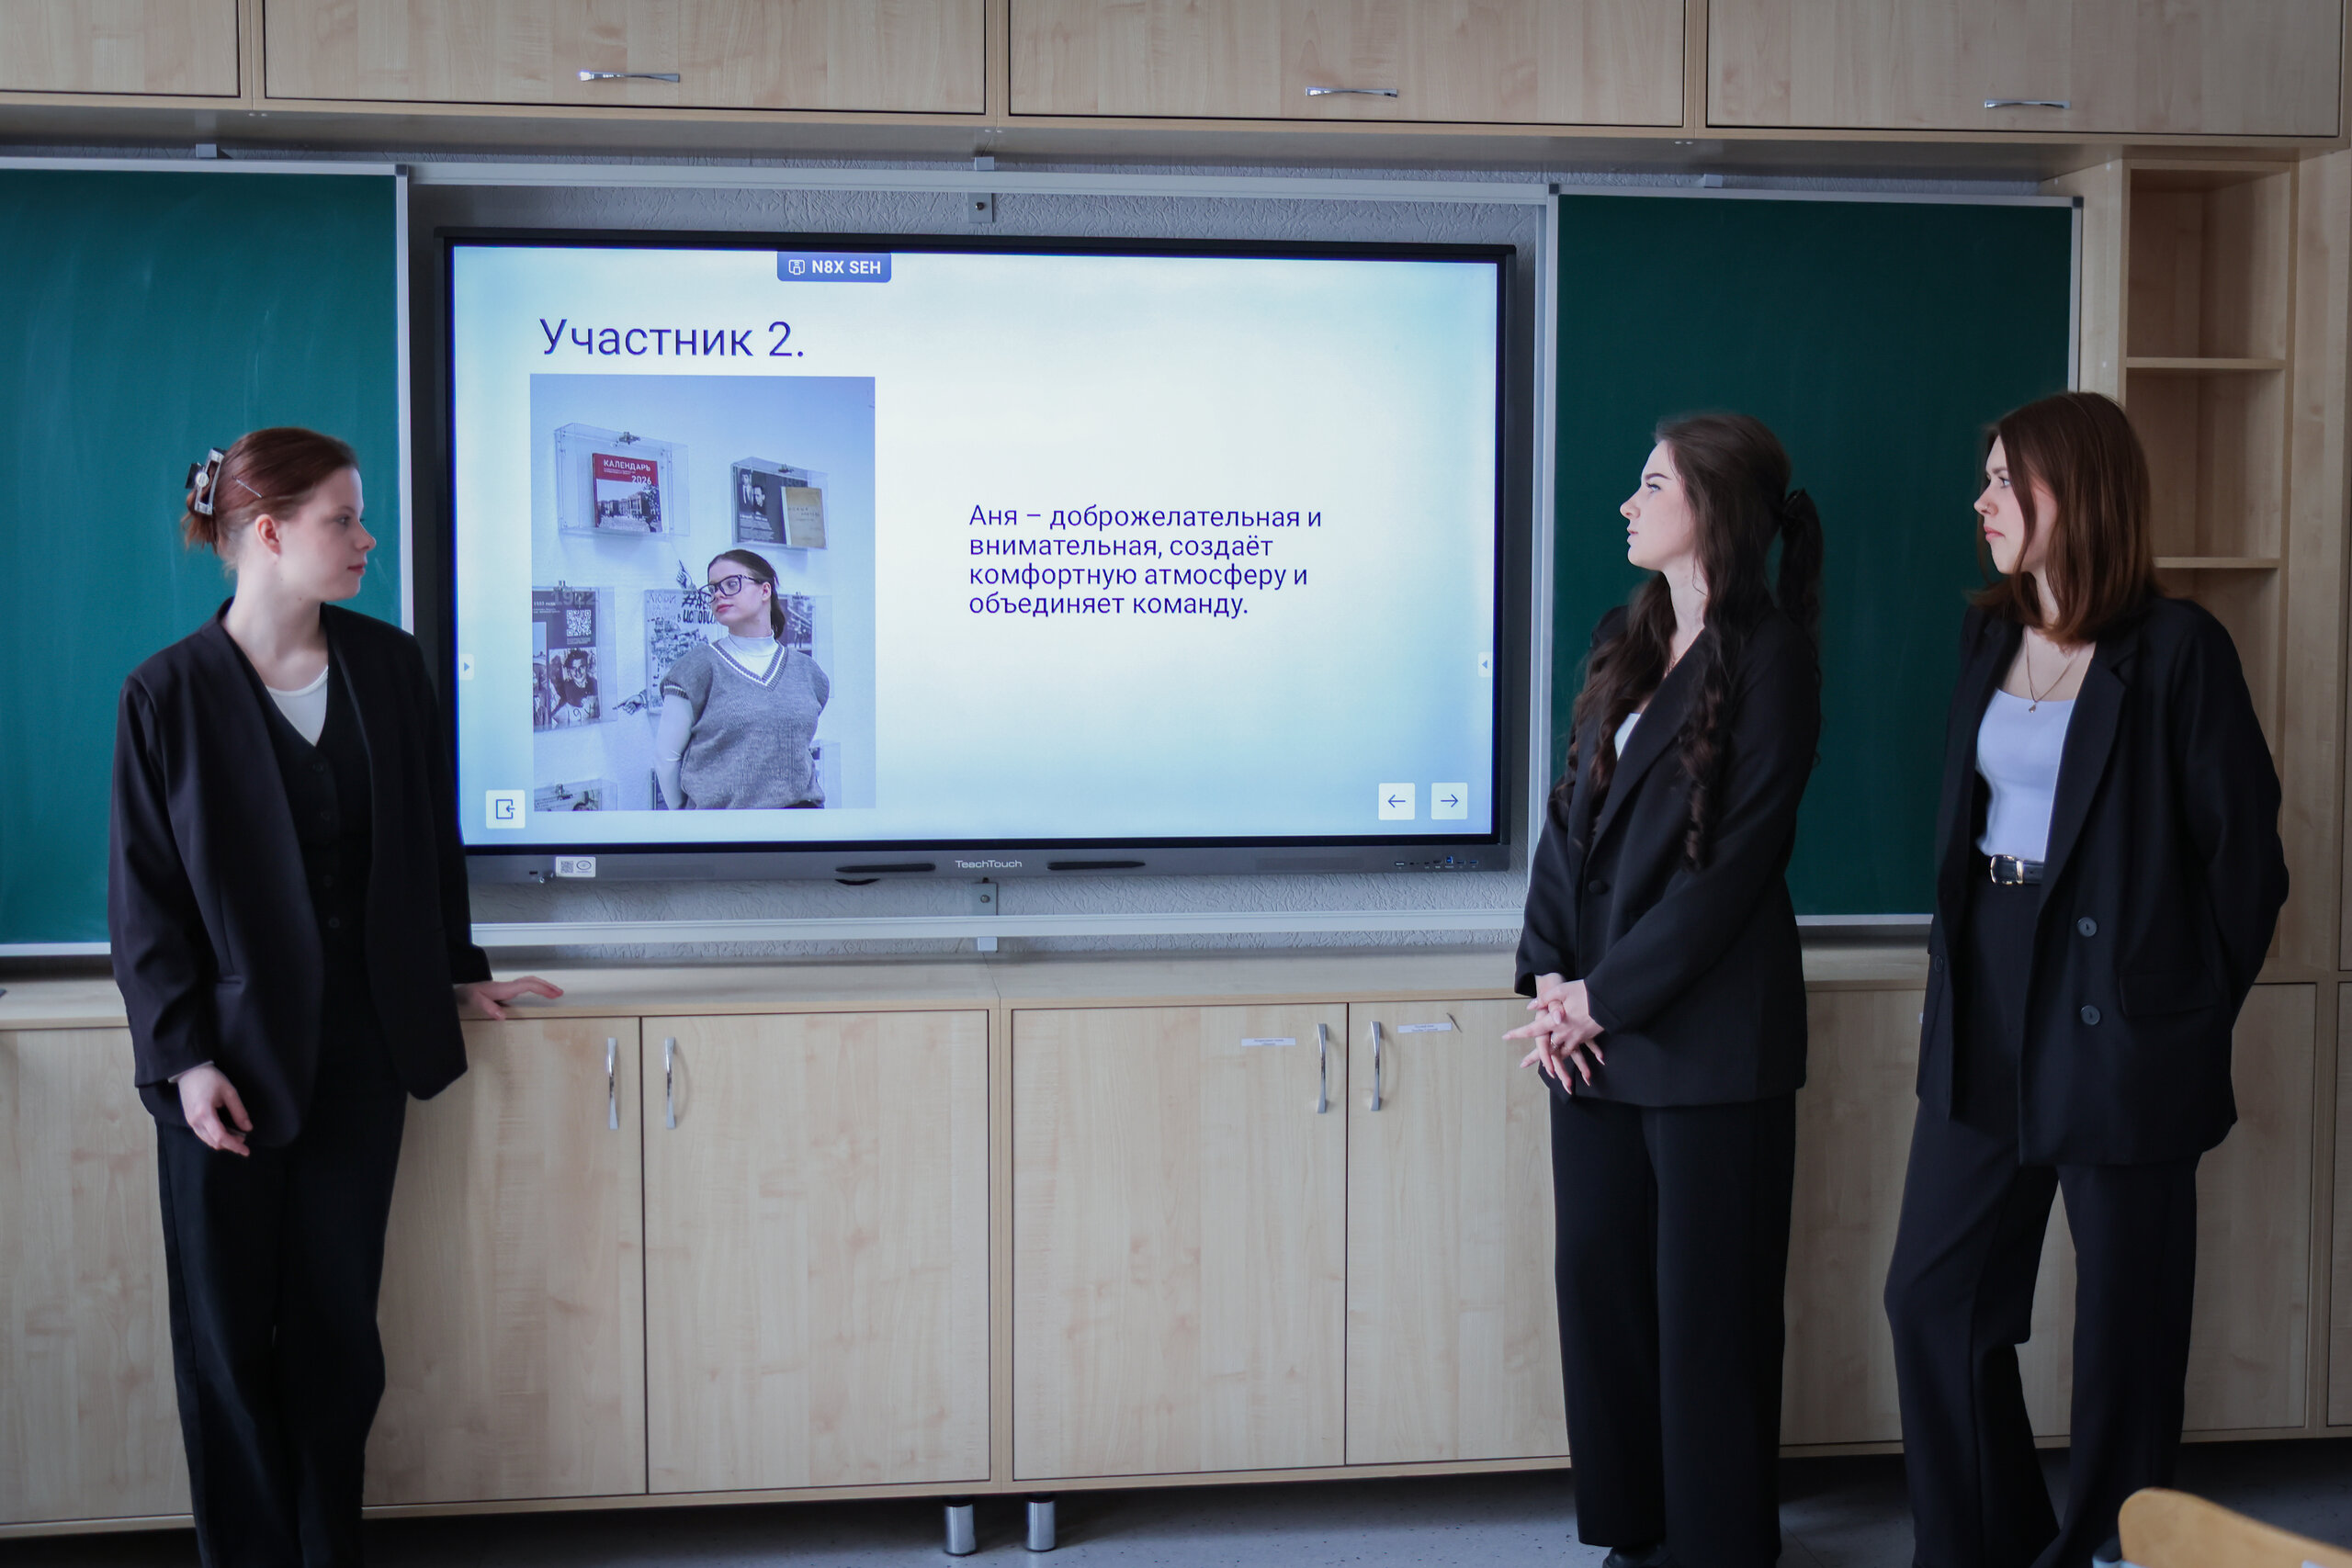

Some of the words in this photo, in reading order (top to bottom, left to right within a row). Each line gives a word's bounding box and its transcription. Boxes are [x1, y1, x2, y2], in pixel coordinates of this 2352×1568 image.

[811, 259, 844, 275] N8X
[849, 260, 881, 275] SEH
[539, 318, 753, 356] Участник
[768, 321, 804, 357] 2.
[603, 459, 651, 472] КАЛЕНДАРЬ
[631, 475, 652, 485] 2026
[969, 504, 1017, 526] Аня
[1049, 503, 1300, 531] доброжелательная
[1308, 511, 1322, 527] и
[969, 538, 1163, 559] внимательная,
[1170, 534, 1274, 559] создаёт
[969, 562, 1136, 591] комфортную
[1145, 562, 1286, 591] атмосферу
[1294, 569, 1308, 585] и
[969, 592, 1125, 617] объединяет
[1133, 598, 1249, 618] команду.
[955, 859, 1023, 869] TeachTouch
